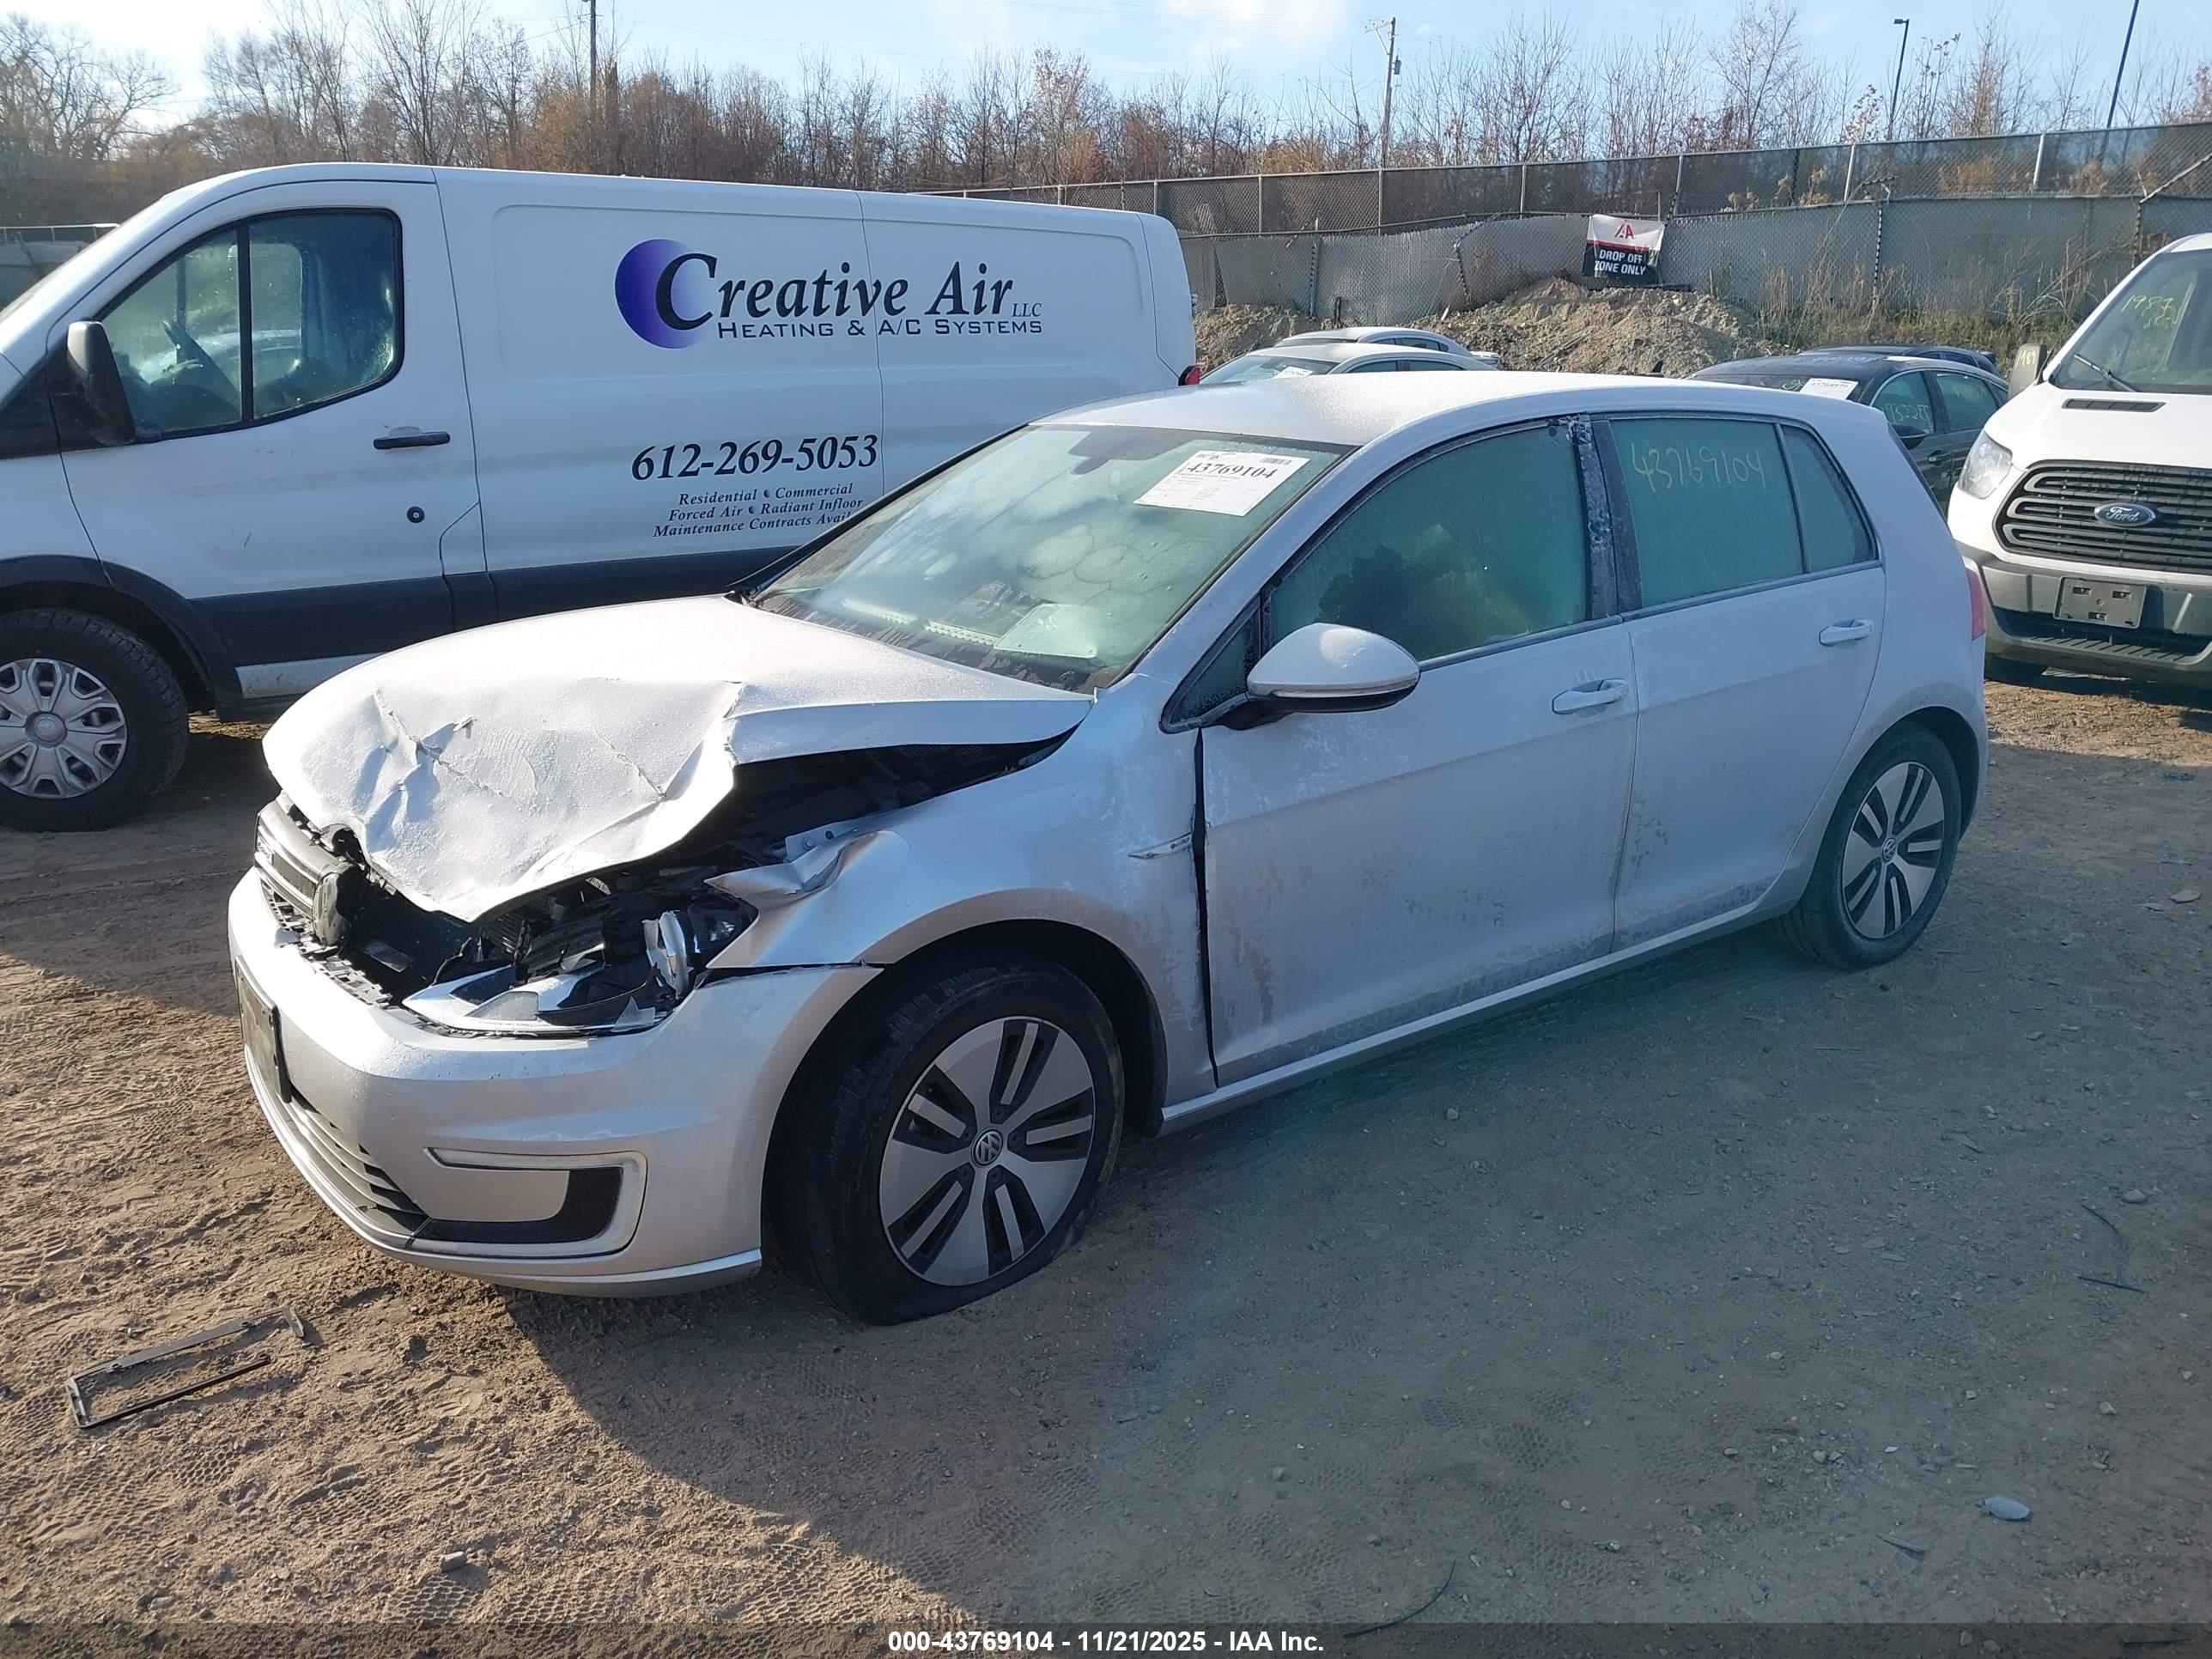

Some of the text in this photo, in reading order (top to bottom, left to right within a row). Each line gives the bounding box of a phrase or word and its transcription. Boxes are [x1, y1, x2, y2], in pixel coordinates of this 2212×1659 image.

[1595, 260, 1646, 275] ZONE ONLY
[1599, 249, 1643, 264] DROP OFF
[655, 252, 1042, 331] Creative Air LLC
[847, 319, 866, 336] &
[878, 319, 921, 336] A/C
[631, 434, 878, 481] 612-269-5053
[1631, 443, 1765, 494] 43769104
[1188, 463, 1279, 478] 43769104
[678, 483, 854, 506] Residential Commercial
[668, 496, 864, 521] Forced Air Radiant Infloor
[2106, 507, 2141, 521] Ford
[653, 523, 744, 538] Maintenance
[749, 516, 812, 530] Contracts
